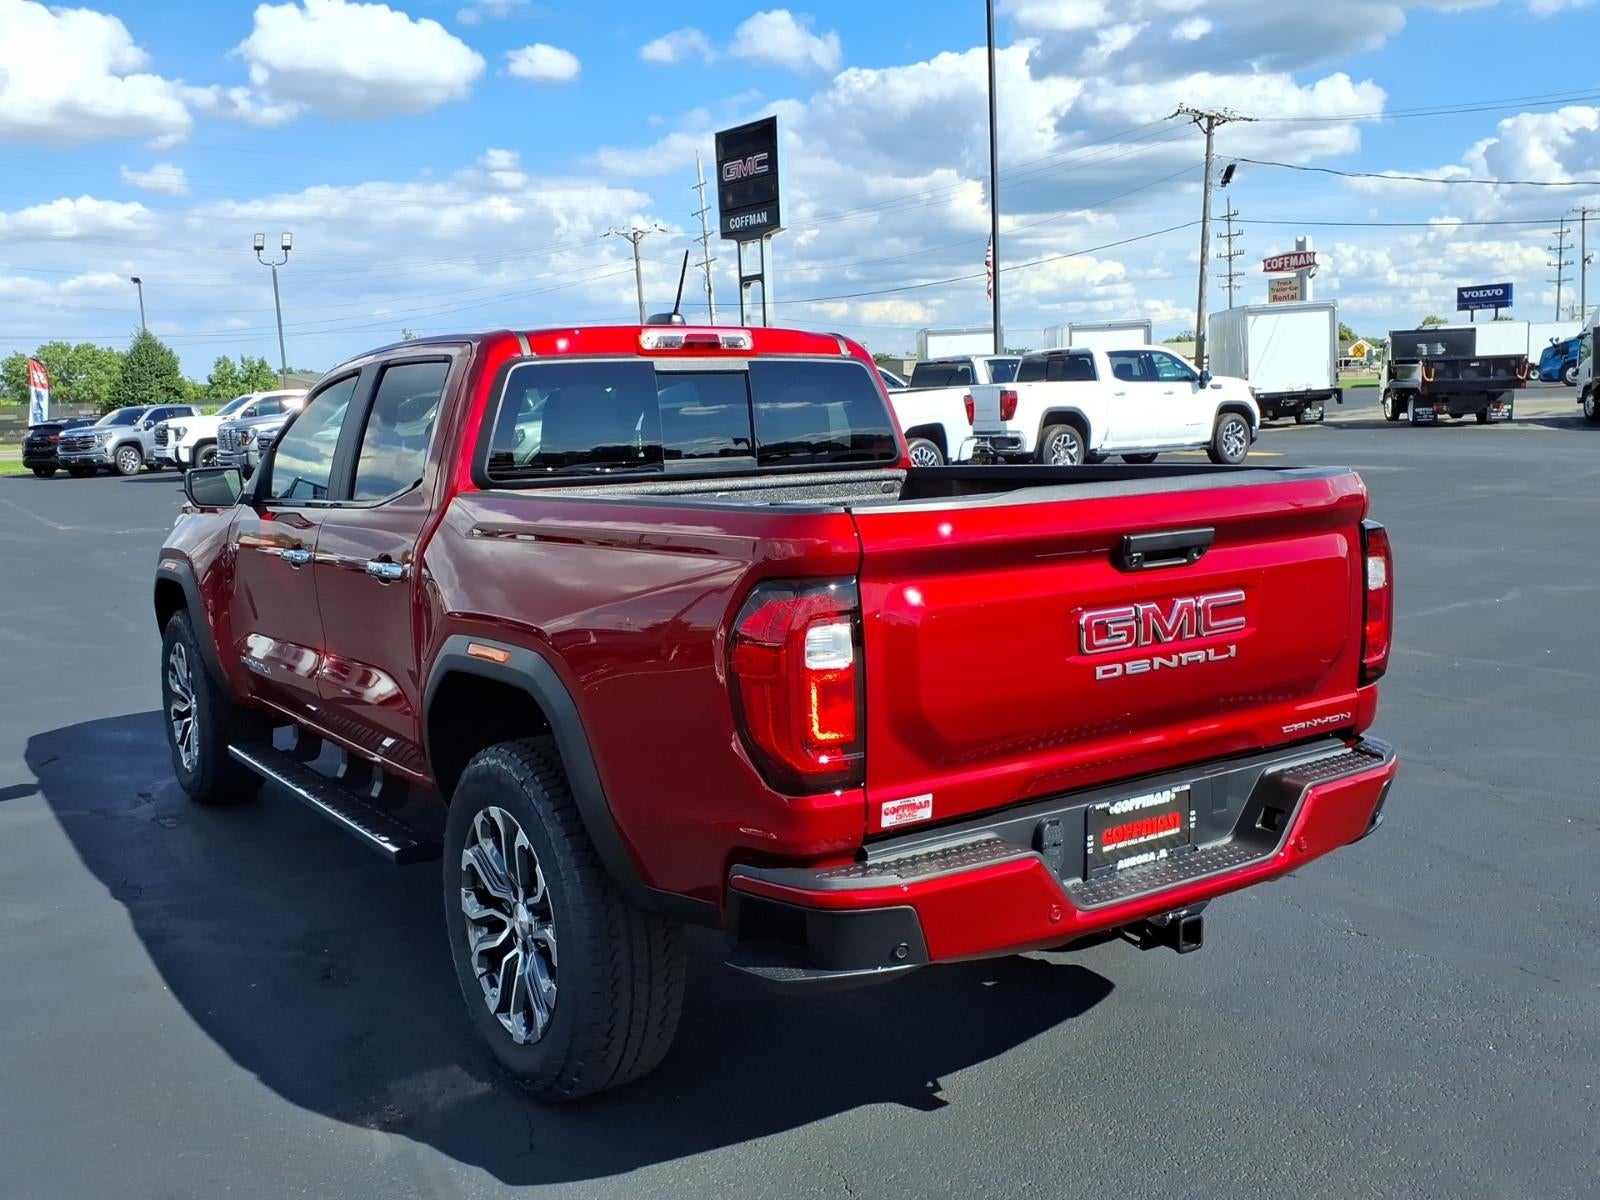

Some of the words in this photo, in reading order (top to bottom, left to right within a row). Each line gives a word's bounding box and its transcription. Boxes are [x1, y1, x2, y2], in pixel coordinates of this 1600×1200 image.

[722, 152, 769, 181] GMC
[729, 211, 768, 230] COFFMAN
[1265, 252, 1314, 270] COFFMAN
[1272, 293, 1297, 302] Rental
[1461, 288, 1504, 299] VOLVO
[1078, 588, 1246, 655] GMC
[1094, 643, 1237, 681] DENALI
[1281, 711, 1352, 734] CANYON
[884, 800, 930, 816] COFFMAN
[1102, 811, 1181, 845] COFFMAN
